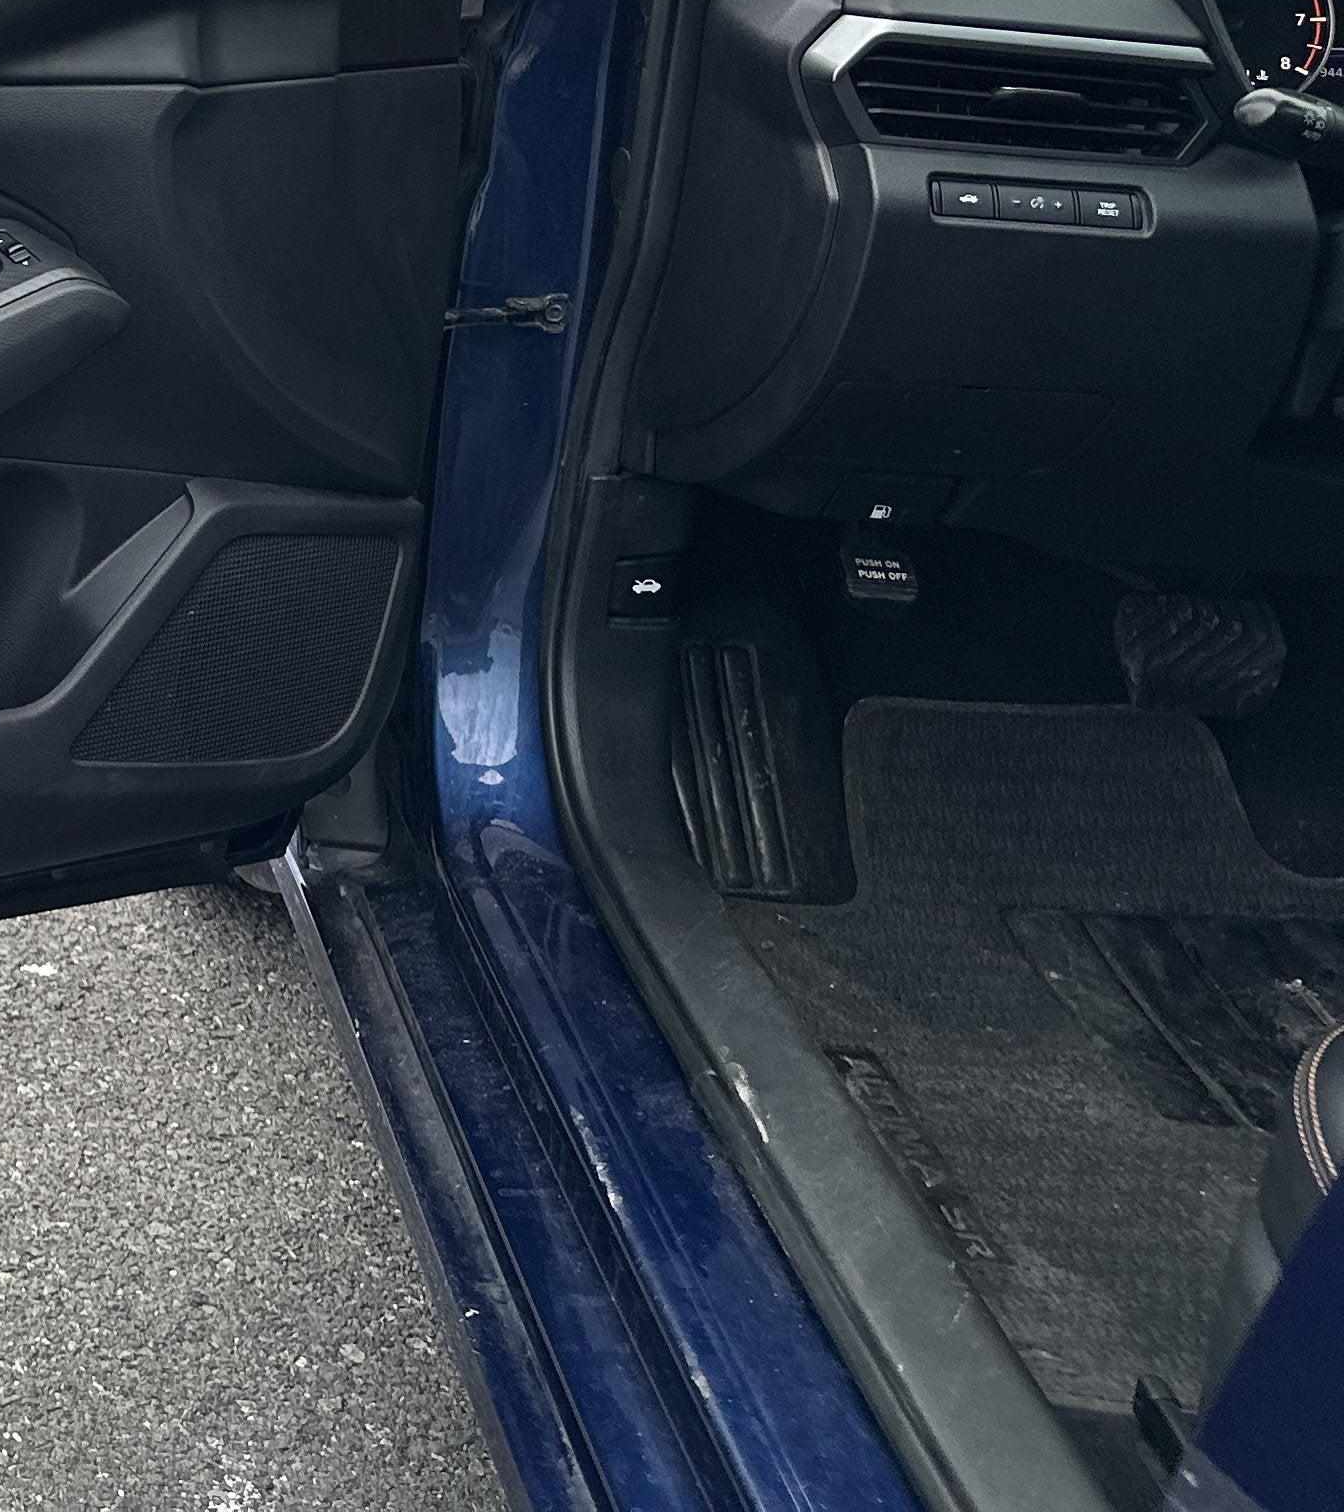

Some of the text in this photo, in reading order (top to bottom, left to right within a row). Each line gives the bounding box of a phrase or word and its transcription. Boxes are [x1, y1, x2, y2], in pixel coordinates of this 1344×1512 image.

[1295, 13, 1306, 26] 7
[1280, 56, 1291, 70] 8
[1099, 201, 1117, 209] TRIP
[1097, 208, 1120, 217] RESET
[854, 557, 901, 569] PUSH ON
[857, 569, 908, 581] PUSH OFF
